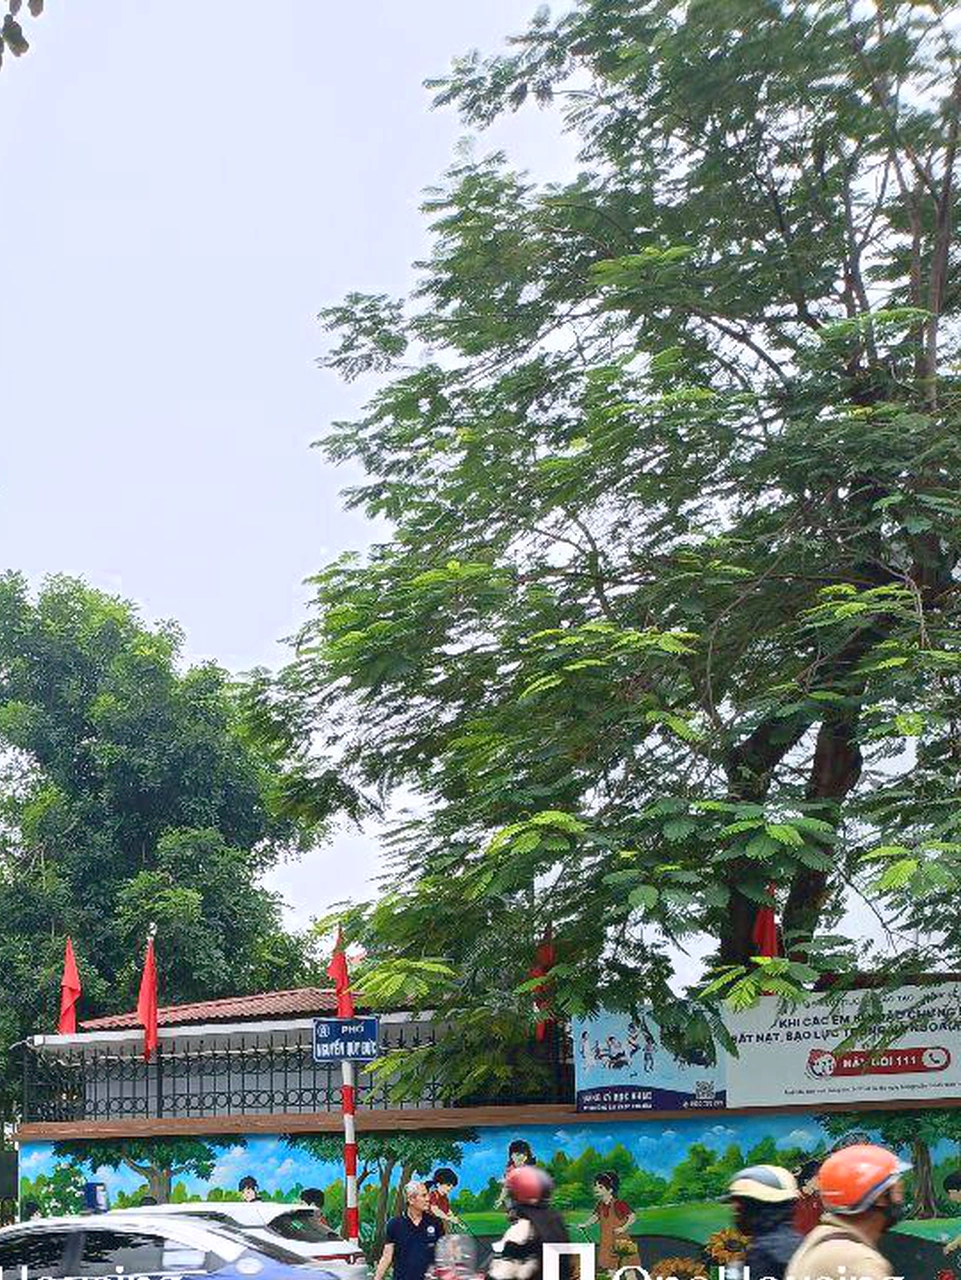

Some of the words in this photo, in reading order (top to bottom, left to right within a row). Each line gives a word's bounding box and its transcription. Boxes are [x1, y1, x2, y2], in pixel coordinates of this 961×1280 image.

[779, 1018, 800, 1029] KHI
[832, 1014, 850, 1025] EM
[896, 1056, 916, 1067] 111
